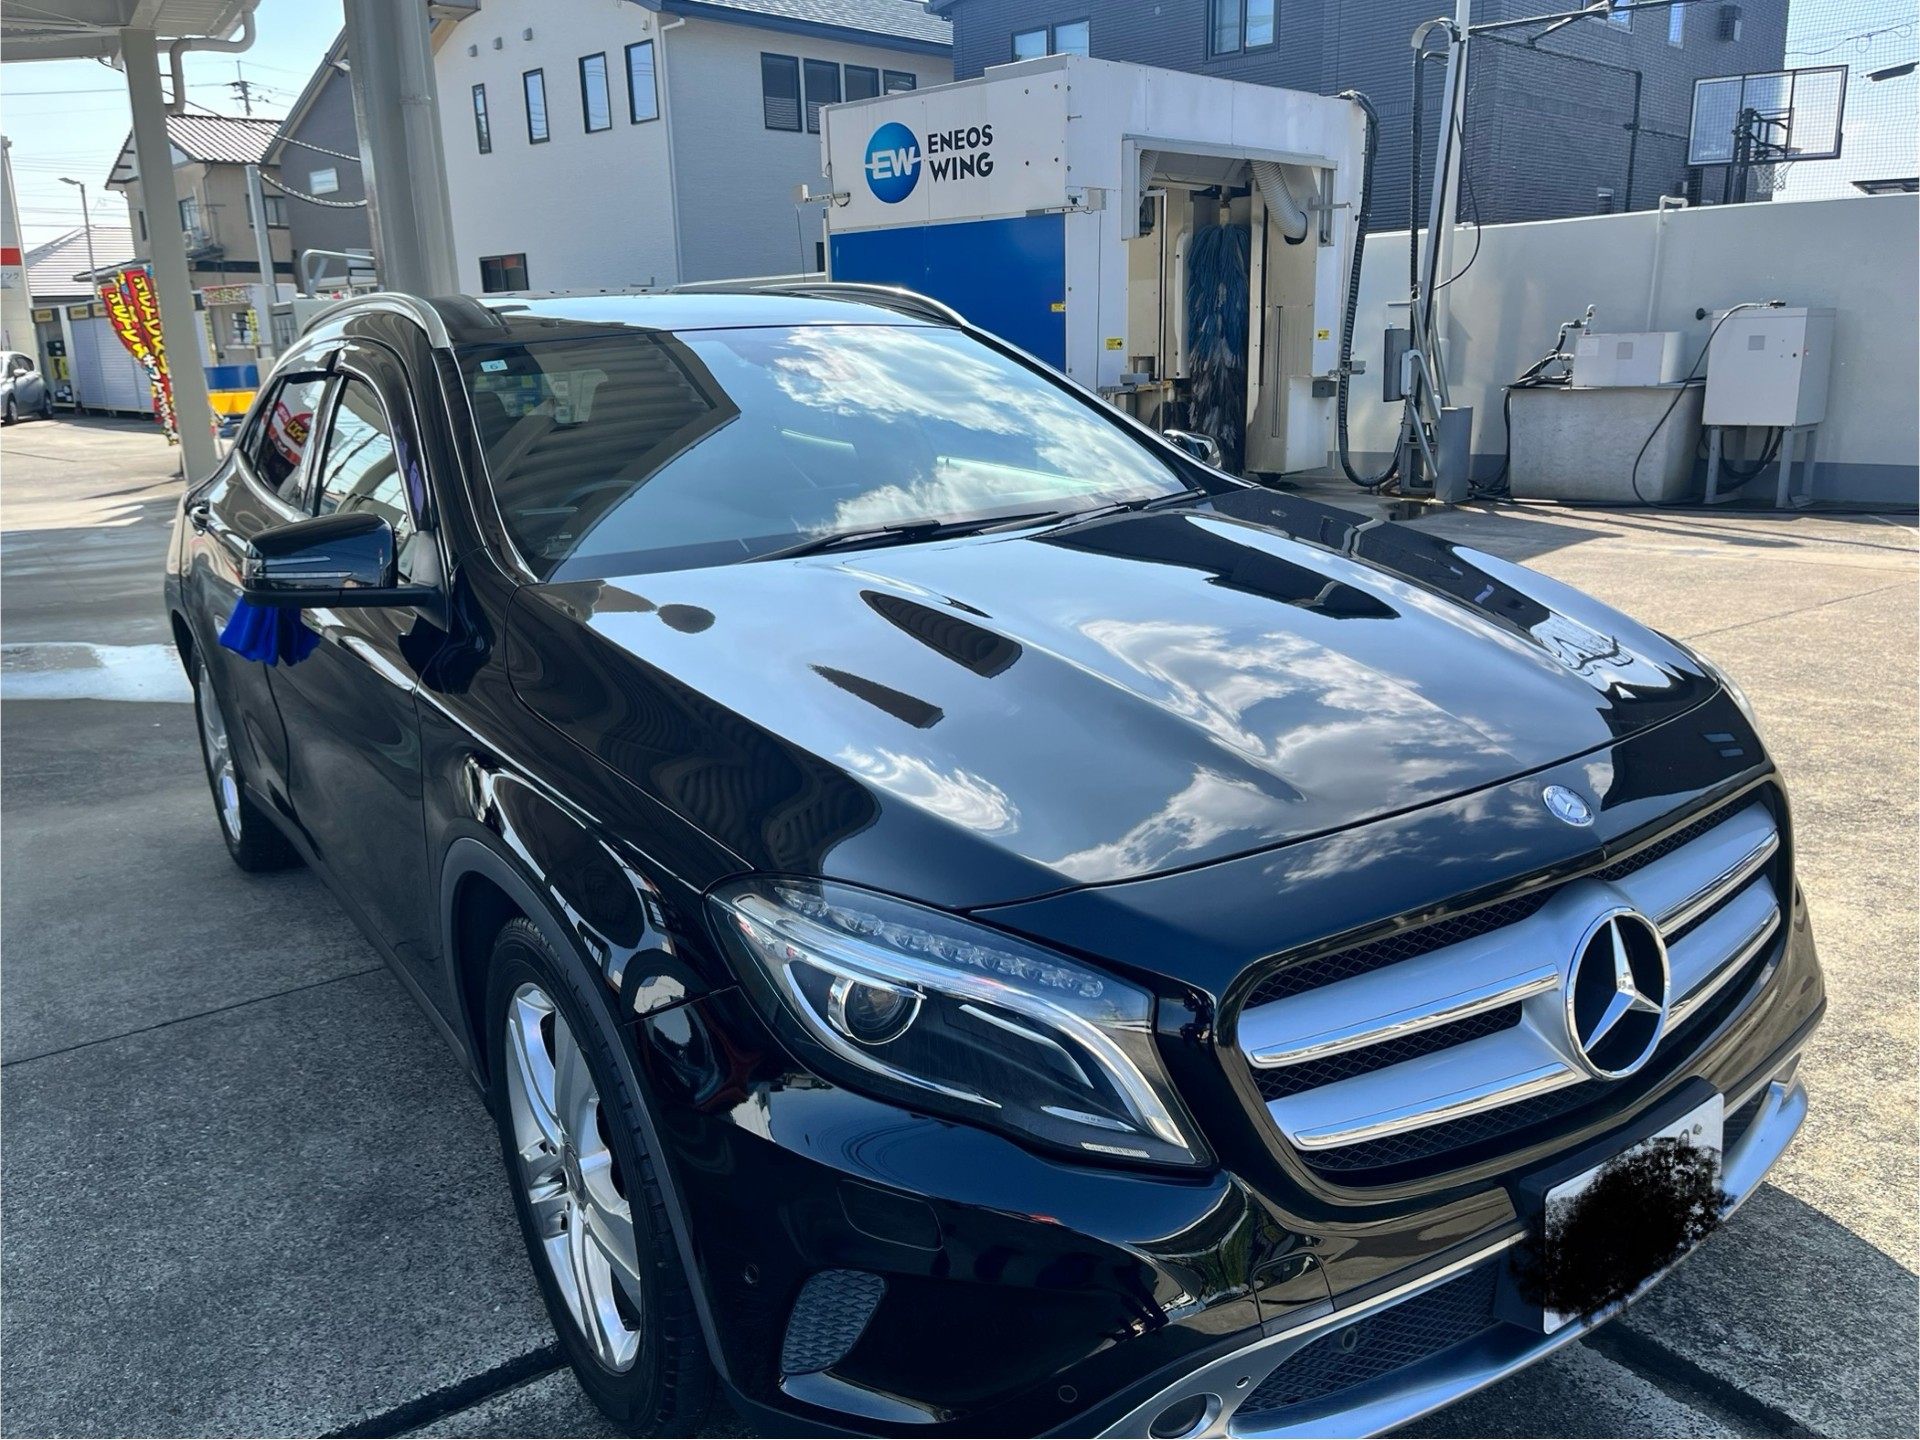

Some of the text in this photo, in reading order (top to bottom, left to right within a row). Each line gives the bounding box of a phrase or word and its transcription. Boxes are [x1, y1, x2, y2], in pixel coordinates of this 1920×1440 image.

[927, 124, 994, 154] ENEOS
[871, 146, 916, 180] EW
[928, 151, 994, 183] WING
